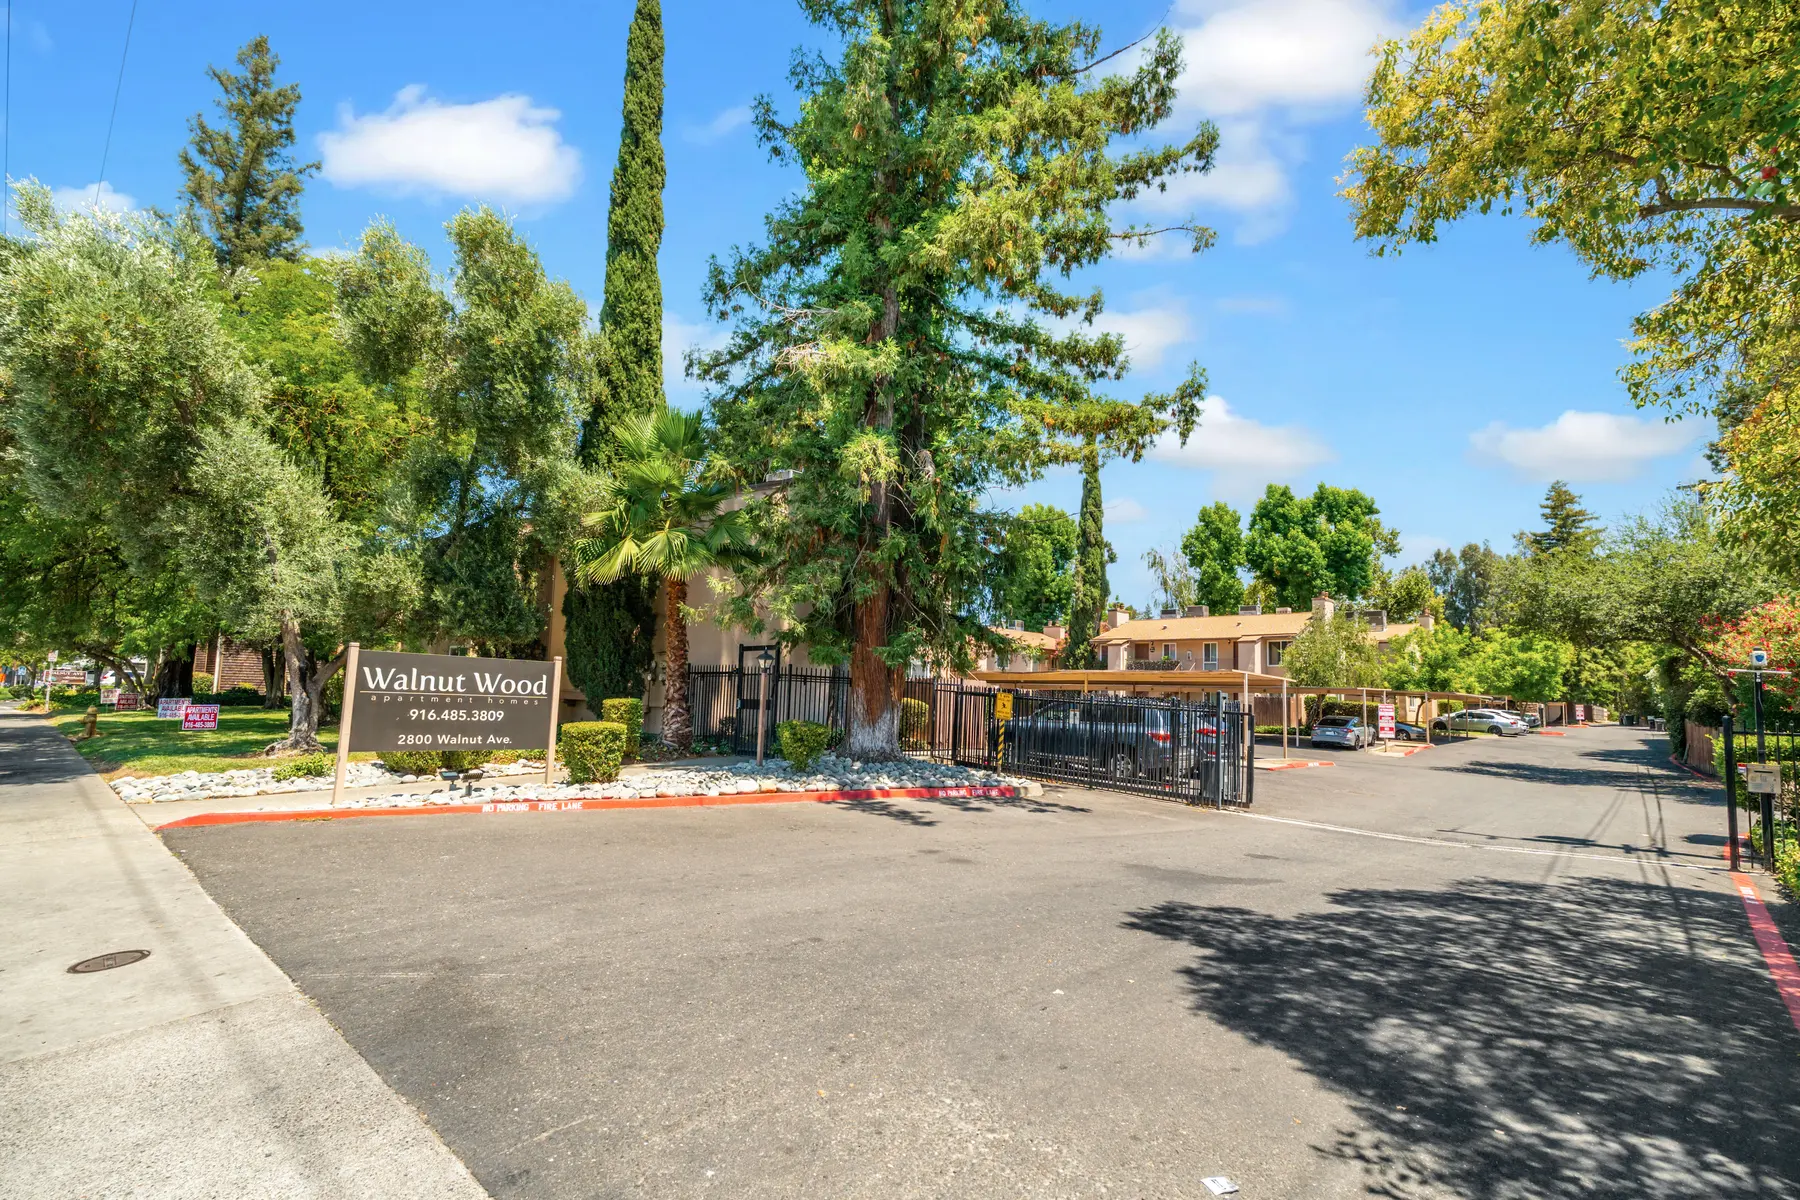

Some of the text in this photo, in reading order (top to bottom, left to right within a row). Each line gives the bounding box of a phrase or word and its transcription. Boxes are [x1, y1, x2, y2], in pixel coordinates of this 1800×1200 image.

[362, 666, 548, 696] Walnut Wood
[371, 695, 539, 705] apartment homes
[409, 708, 505, 721] 916.485.3809
[397, 734, 513, 745] 2800 Walnut Ave.
[481, 802, 584, 812] NO PARKING FIRE LANE
